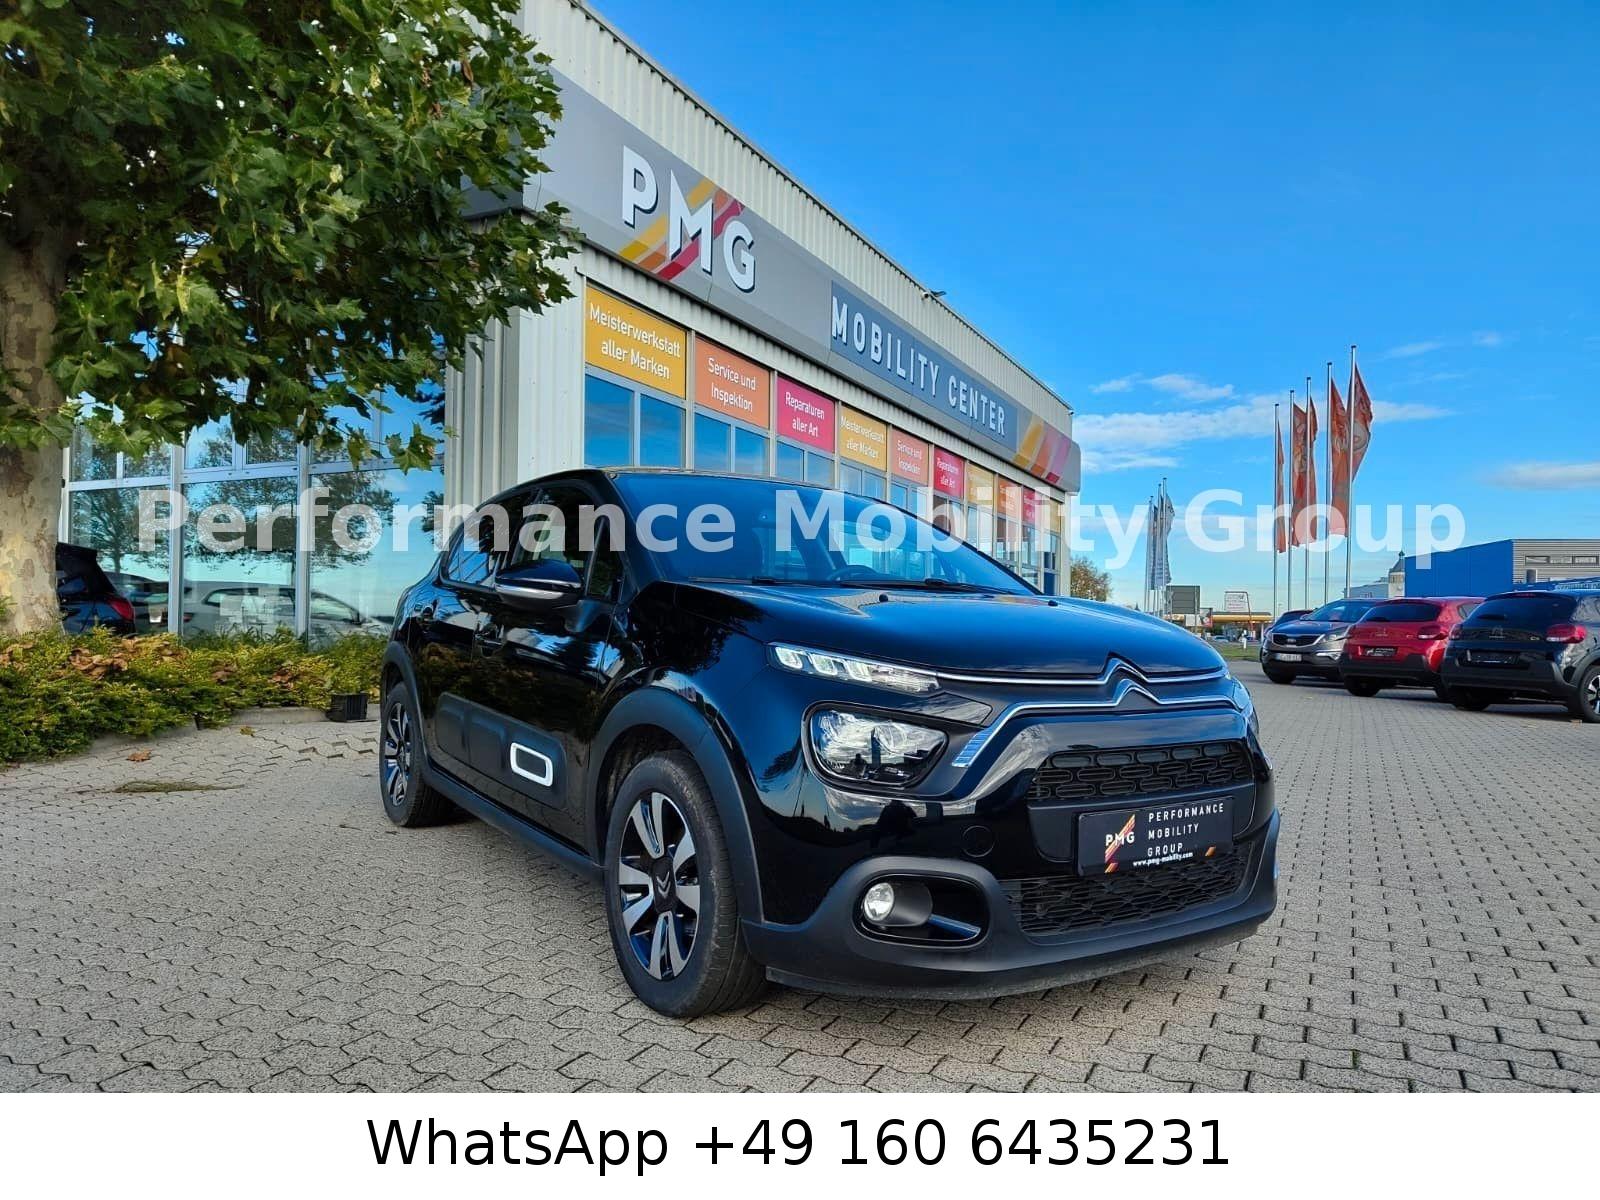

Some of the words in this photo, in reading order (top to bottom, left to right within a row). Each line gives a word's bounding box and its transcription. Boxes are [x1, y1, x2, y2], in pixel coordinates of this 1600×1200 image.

[622, 145, 756, 293] PMG
[590, 302, 681, 358] Meisterwerkstatt
[601, 339, 628, 362] aller
[630, 348, 670, 380] Marken
[708, 357, 740, 383] Service
[741, 376, 756, 391] und
[832, 295, 939, 398] MOBILITY
[949, 375, 1006, 437] CENTER
[711, 382, 753, 412] Inspektion
[785, 391, 825, 420] Reparaturen
[792, 417, 807, 433] aller
[808, 422, 819, 437] Art
[1148, 803, 1224, 823] PERFORMANCE
[1105, 831, 1135, 847] PMG
[1148, 823, 1199, 840] MOBILITY
[1147, 843, 1183, 857] GROUP
